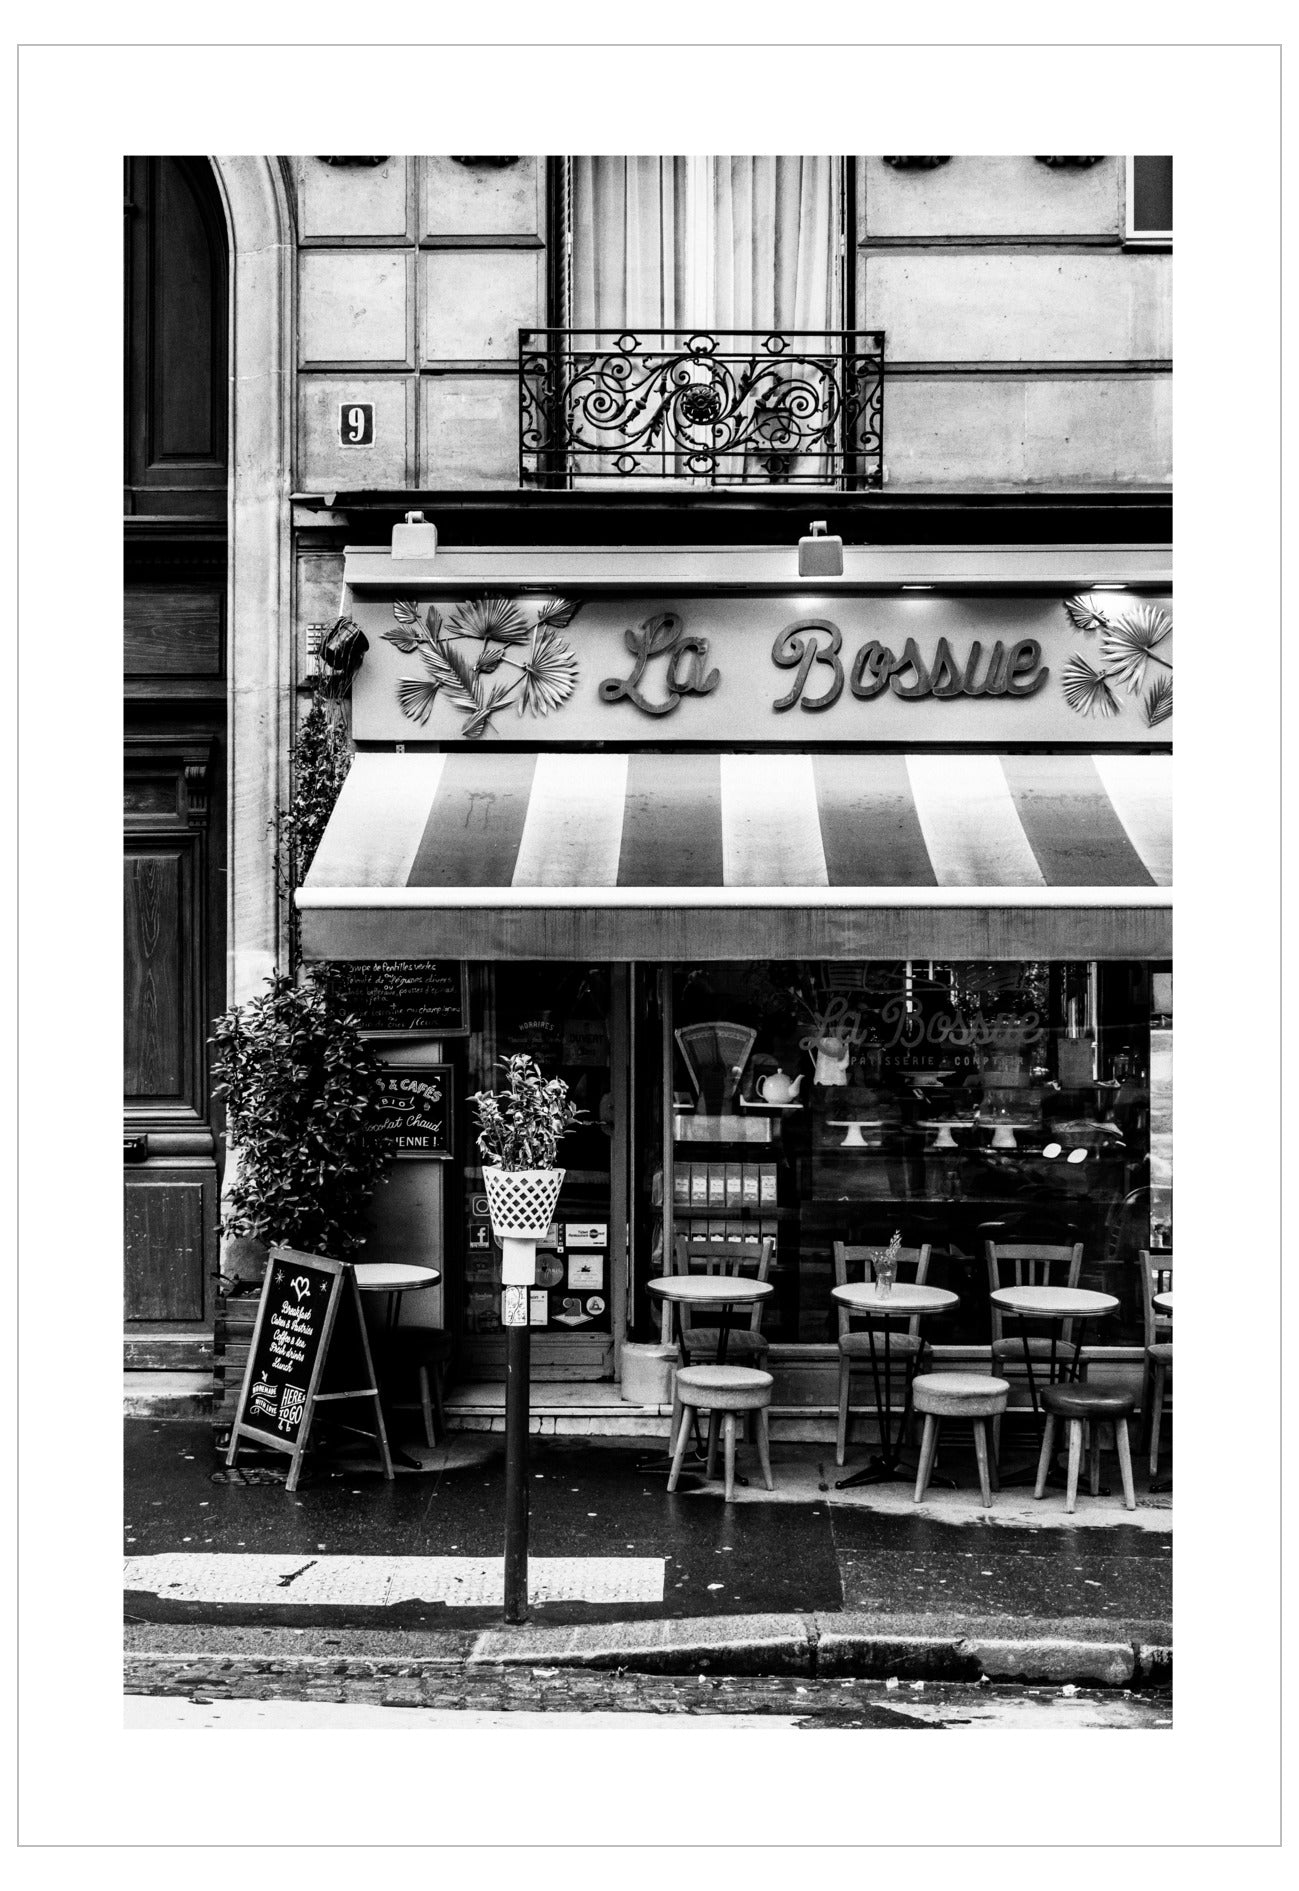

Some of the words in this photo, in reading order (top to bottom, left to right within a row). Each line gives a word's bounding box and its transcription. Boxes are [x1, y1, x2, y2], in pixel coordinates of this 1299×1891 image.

[348, 407, 364, 442] 9
[600, 610, 720, 715] La
[771, 617, 1051, 713] Bossue
[798, 996, 868, 1051] La
[400, 1078, 442, 1103] CAFÉS
[406, 1113, 443, 1132] Chaud
[281, 1300, 312, 1322] Breakfast
[271, 1313, 286, 1327] Cakes
[291, 1321, 314, 1336] Pastries
[273, 1329, 291, 1346] Coffee
[269, 1341, 287, 1356] Fresh
[285, 1347, 305, 1362] drinks
[272, 1356, 293, 1373] Lunch
[252, 1385, 277, 1395] HOMEMADE
[280, 1387, 303, 1407] HERE
[255, 1398, 267, 1409] WITH
[266, 1404, 278, 1414] LOVE
[279, 1408, 289, 1418] TO
[289, 1405, 303, 1424] GO
